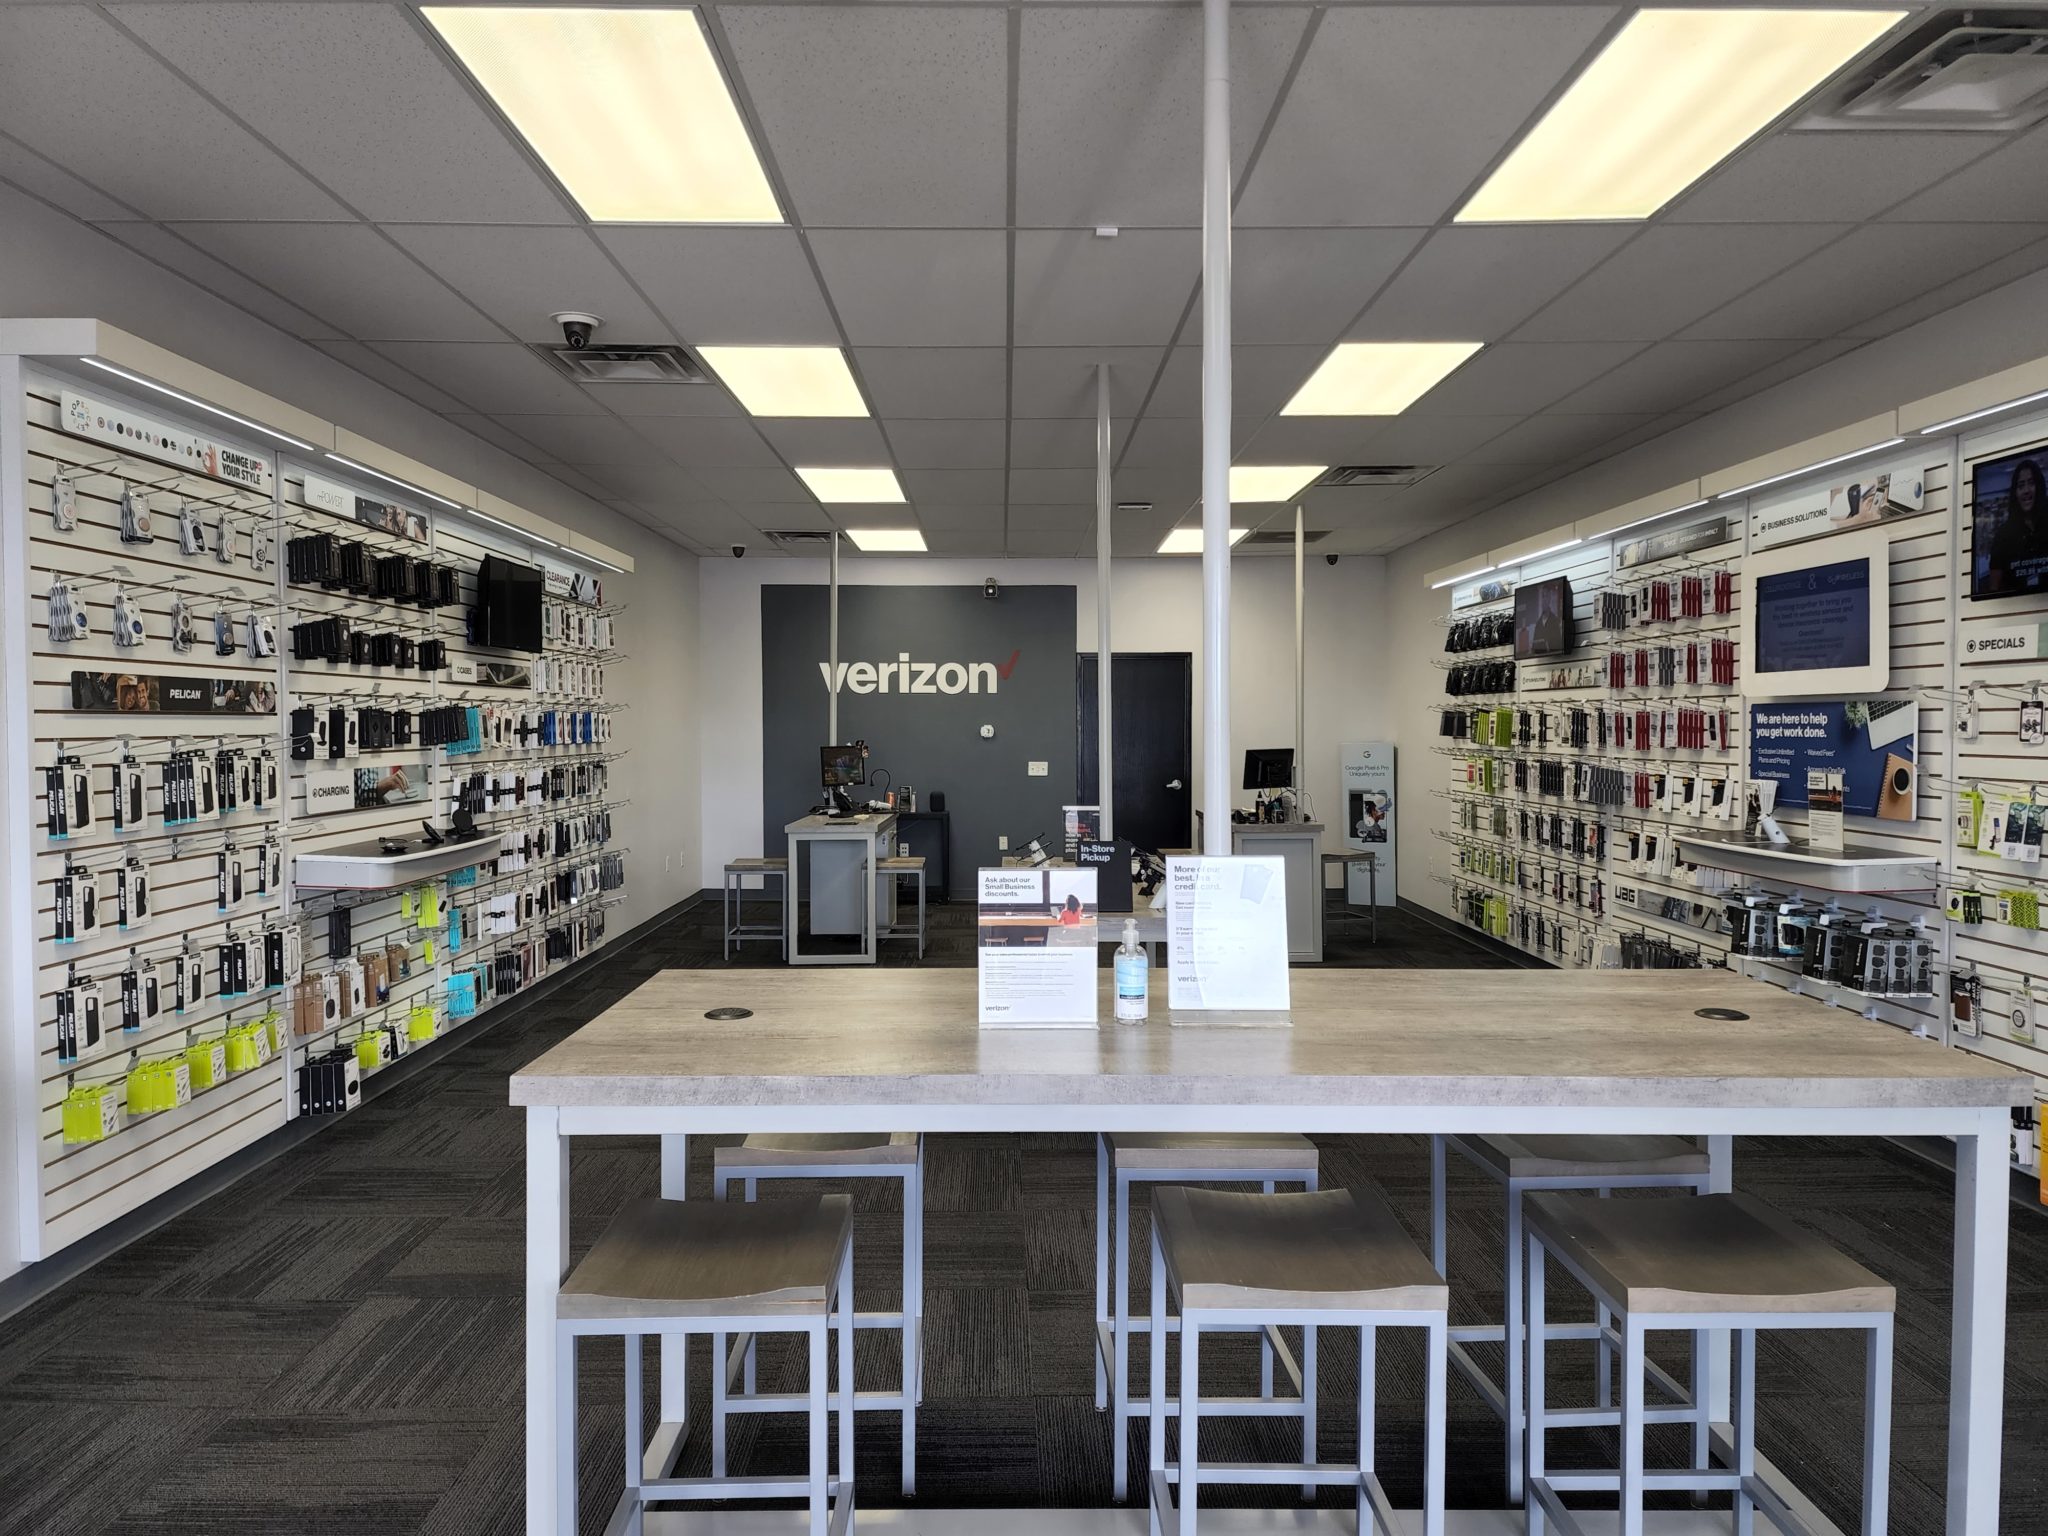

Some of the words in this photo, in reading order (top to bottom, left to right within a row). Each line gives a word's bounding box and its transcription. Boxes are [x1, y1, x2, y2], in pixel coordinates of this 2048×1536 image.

[221, 450, 249, 469] CHANGE
[249, 459, 258, 471] UP
[222, 462, 240, 480] YOUR
[241, 470, 261, 485] STYLE
[1767, 516, 1795, 530] BUSINESS
[1794, 507, 1828, 524] SOLUTIONS
[1978, 636, 2026, 651] SPECIALS
[818, 652, 998, 695] verizon
[169, 689, 201, 700] PELICAN
[1756, 713, 1768, 724] We
[1768, 715, 1781, 724] are
[1781, 712, 1800, 724] here
[1800, 713, 1809, 724] to
[1809, 712, 1828, 726] help
[1755, 728, 1770, 739] you
[1770, 726, 1783, 739] get
[1783, 726, 1804, 737] work
[1804, 726, 1827, 738] done.
[1363, 750, 1371, 759] G
[317, 785, 350, 798] CHARGING
[1080, 844, 1115, 853] In-Store
[1080, 853, 1111, 863] Pickup
[1174, 865, 1196, 873] More
[1614, 885, 1636, 903] UAG
[985, 1004, 1010, 1012] verizon
